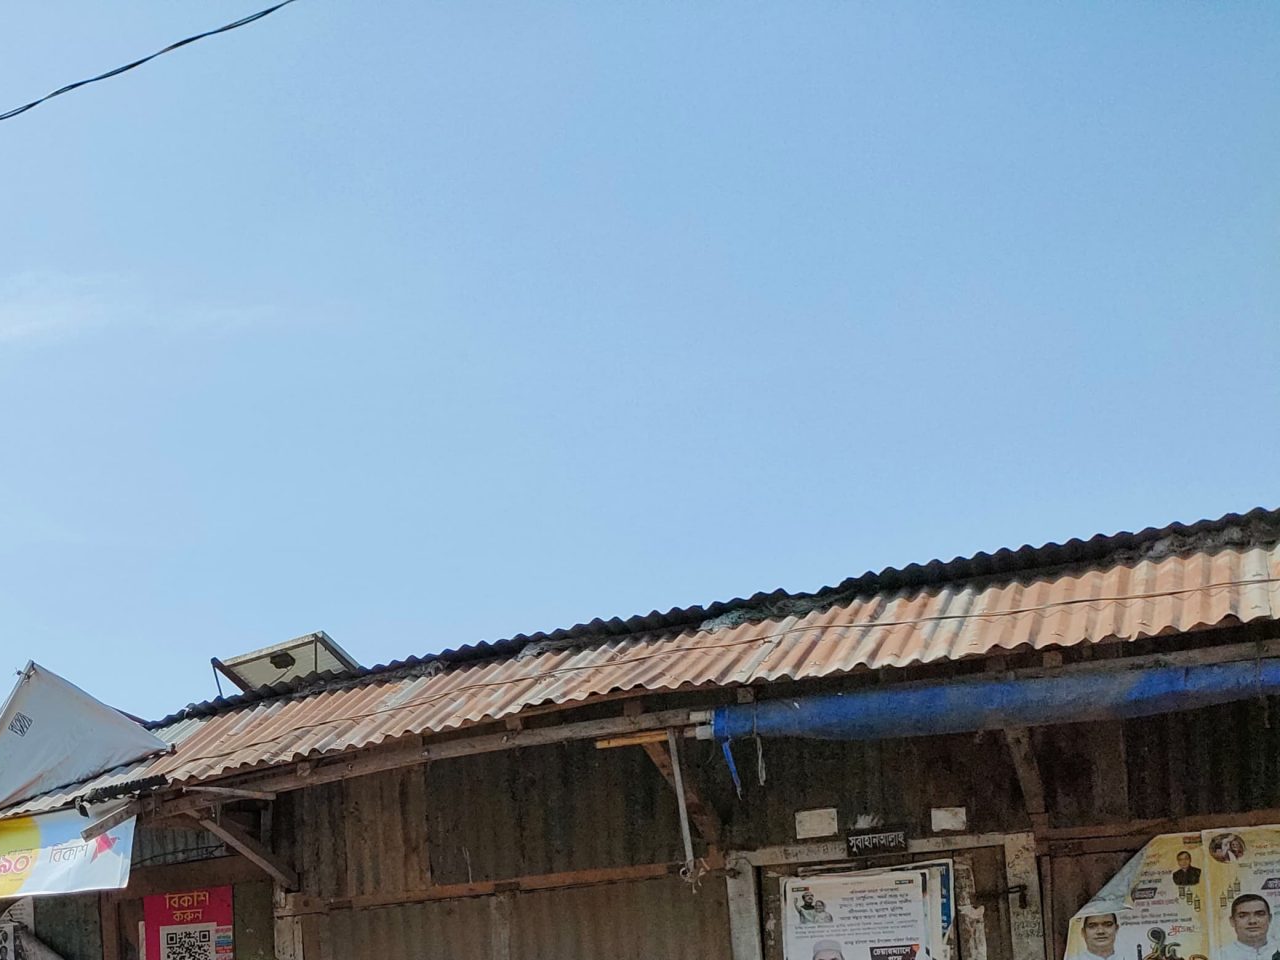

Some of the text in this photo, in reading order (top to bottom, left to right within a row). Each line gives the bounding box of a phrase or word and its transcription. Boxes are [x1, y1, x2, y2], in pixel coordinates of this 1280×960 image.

[49, 844, 88, 863] বিকাশ
[165, 890, 209, 909] বিকাশ
[172, 908, 202, 922] করুন
